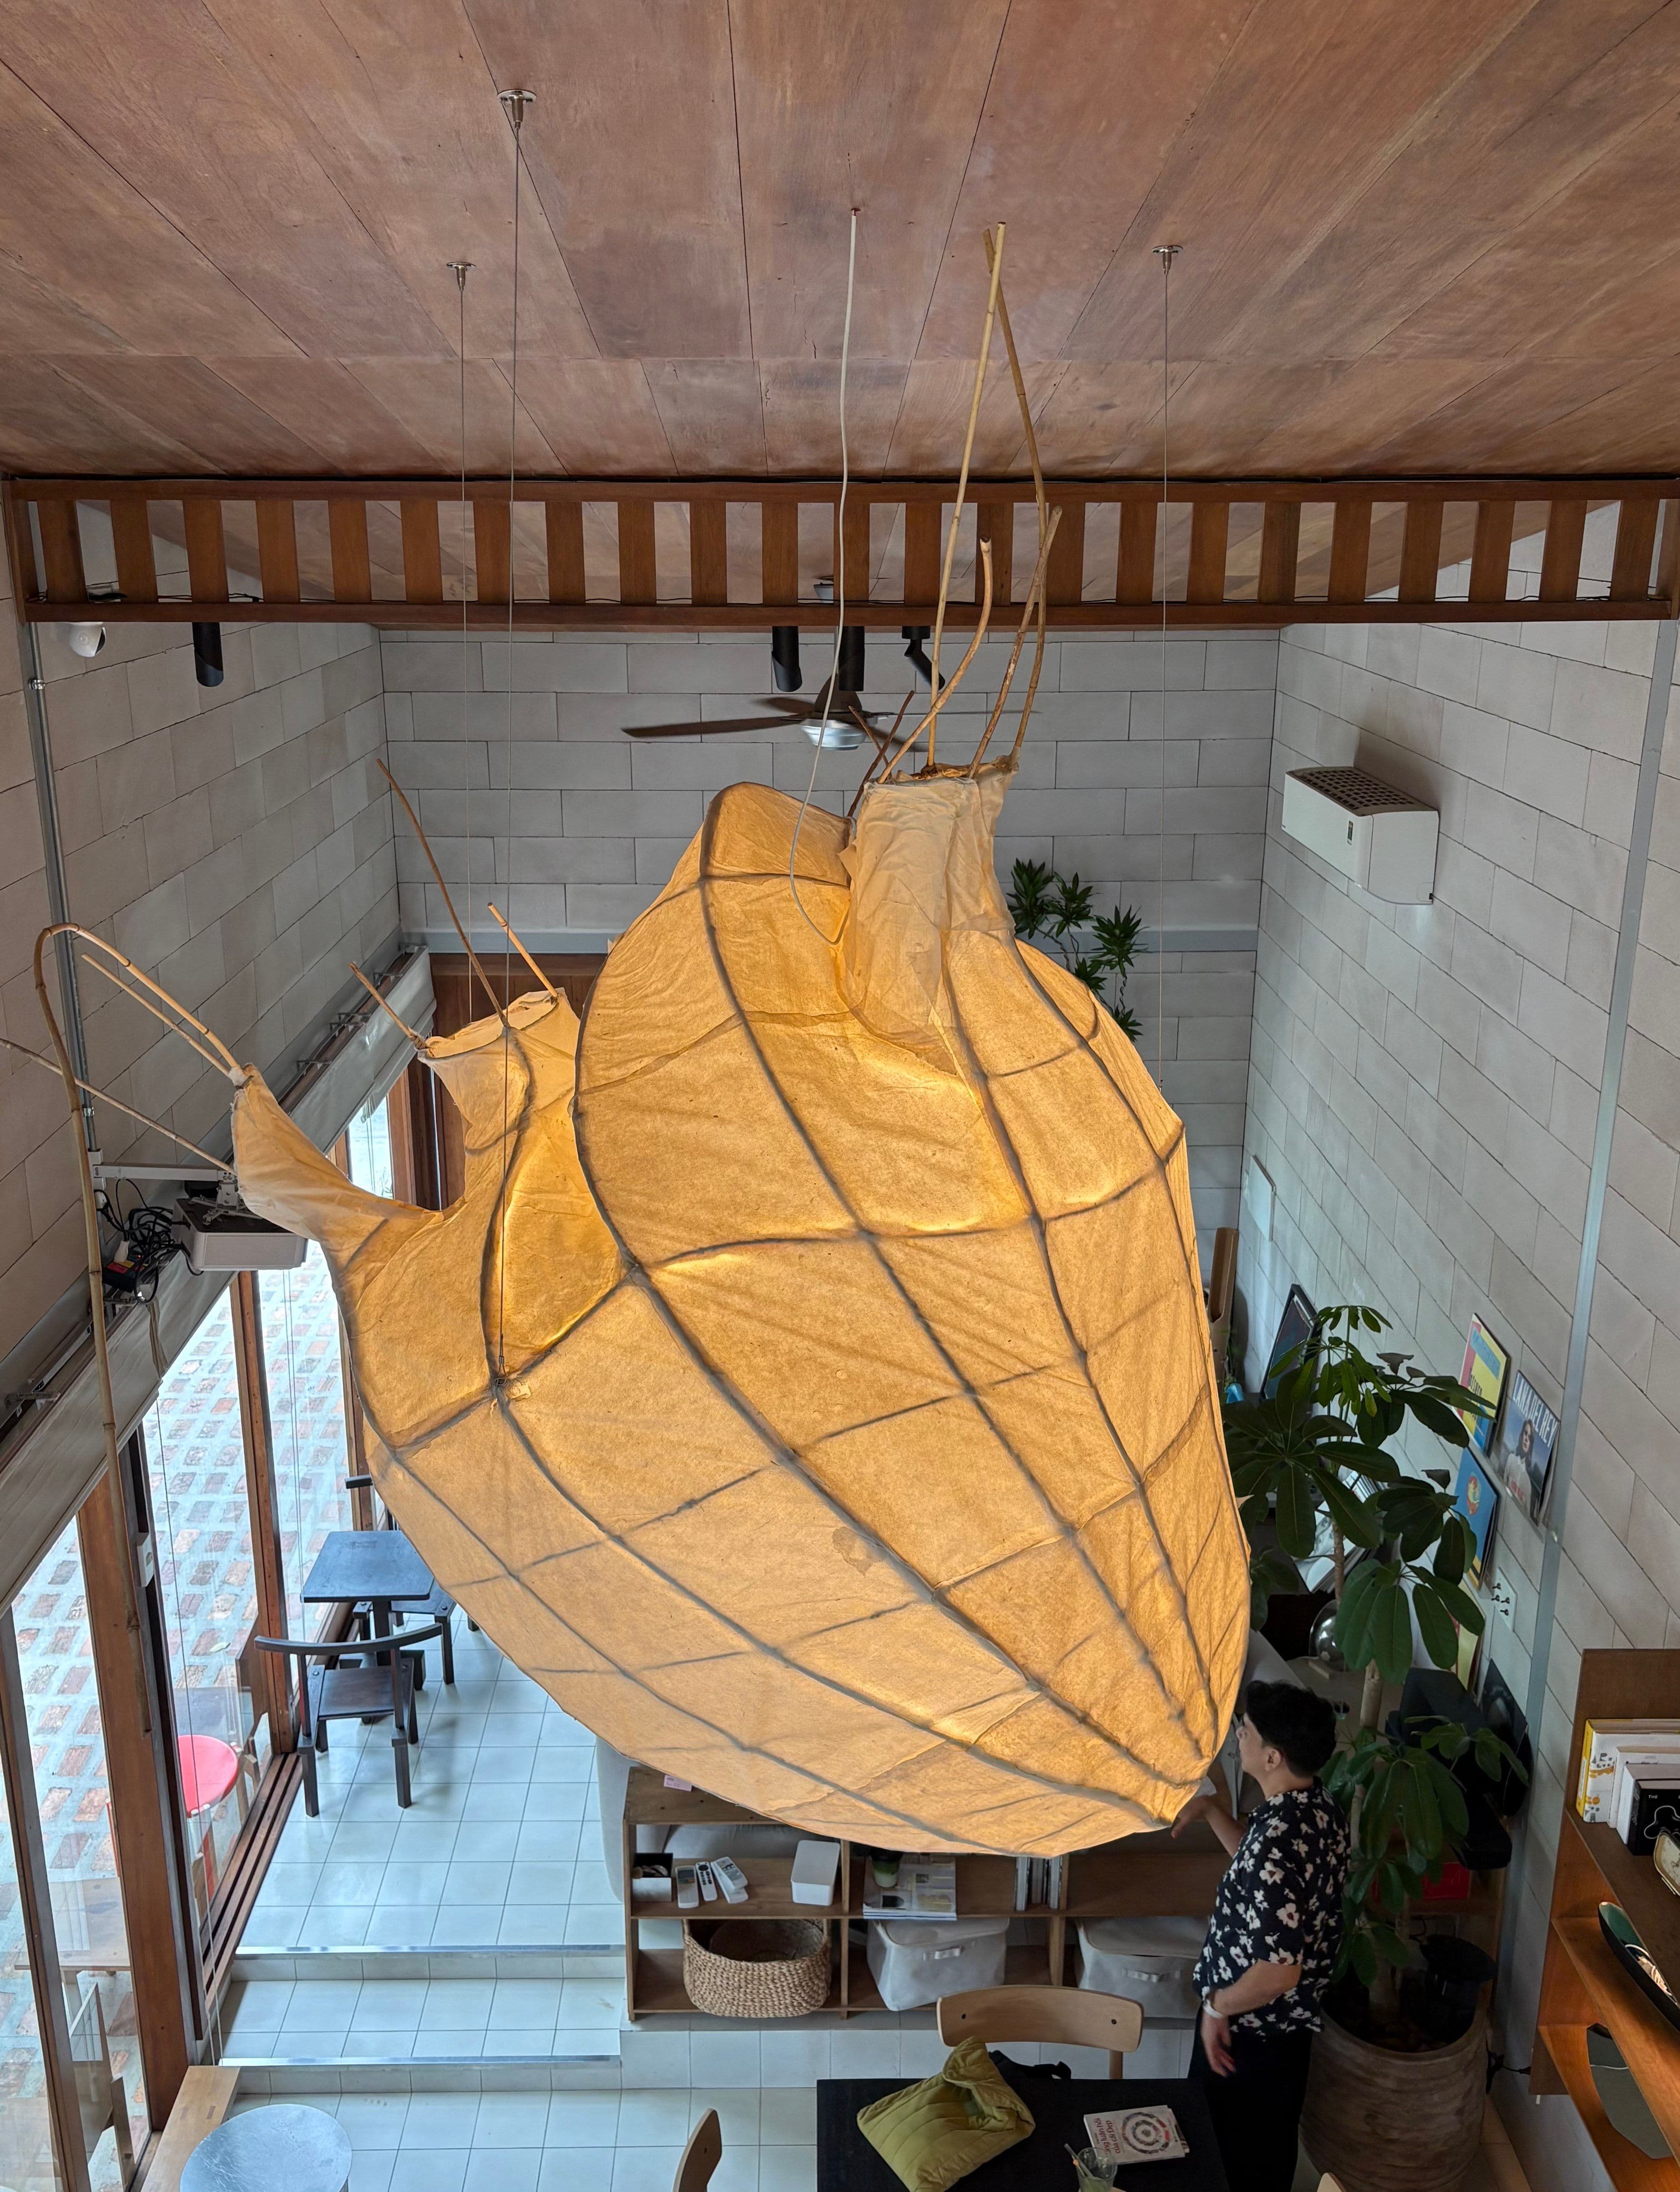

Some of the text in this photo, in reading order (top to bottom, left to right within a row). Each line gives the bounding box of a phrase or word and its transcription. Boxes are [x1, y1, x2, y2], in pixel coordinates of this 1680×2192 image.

[1513, 1372, 1558, 1448] LANA DEL REY
